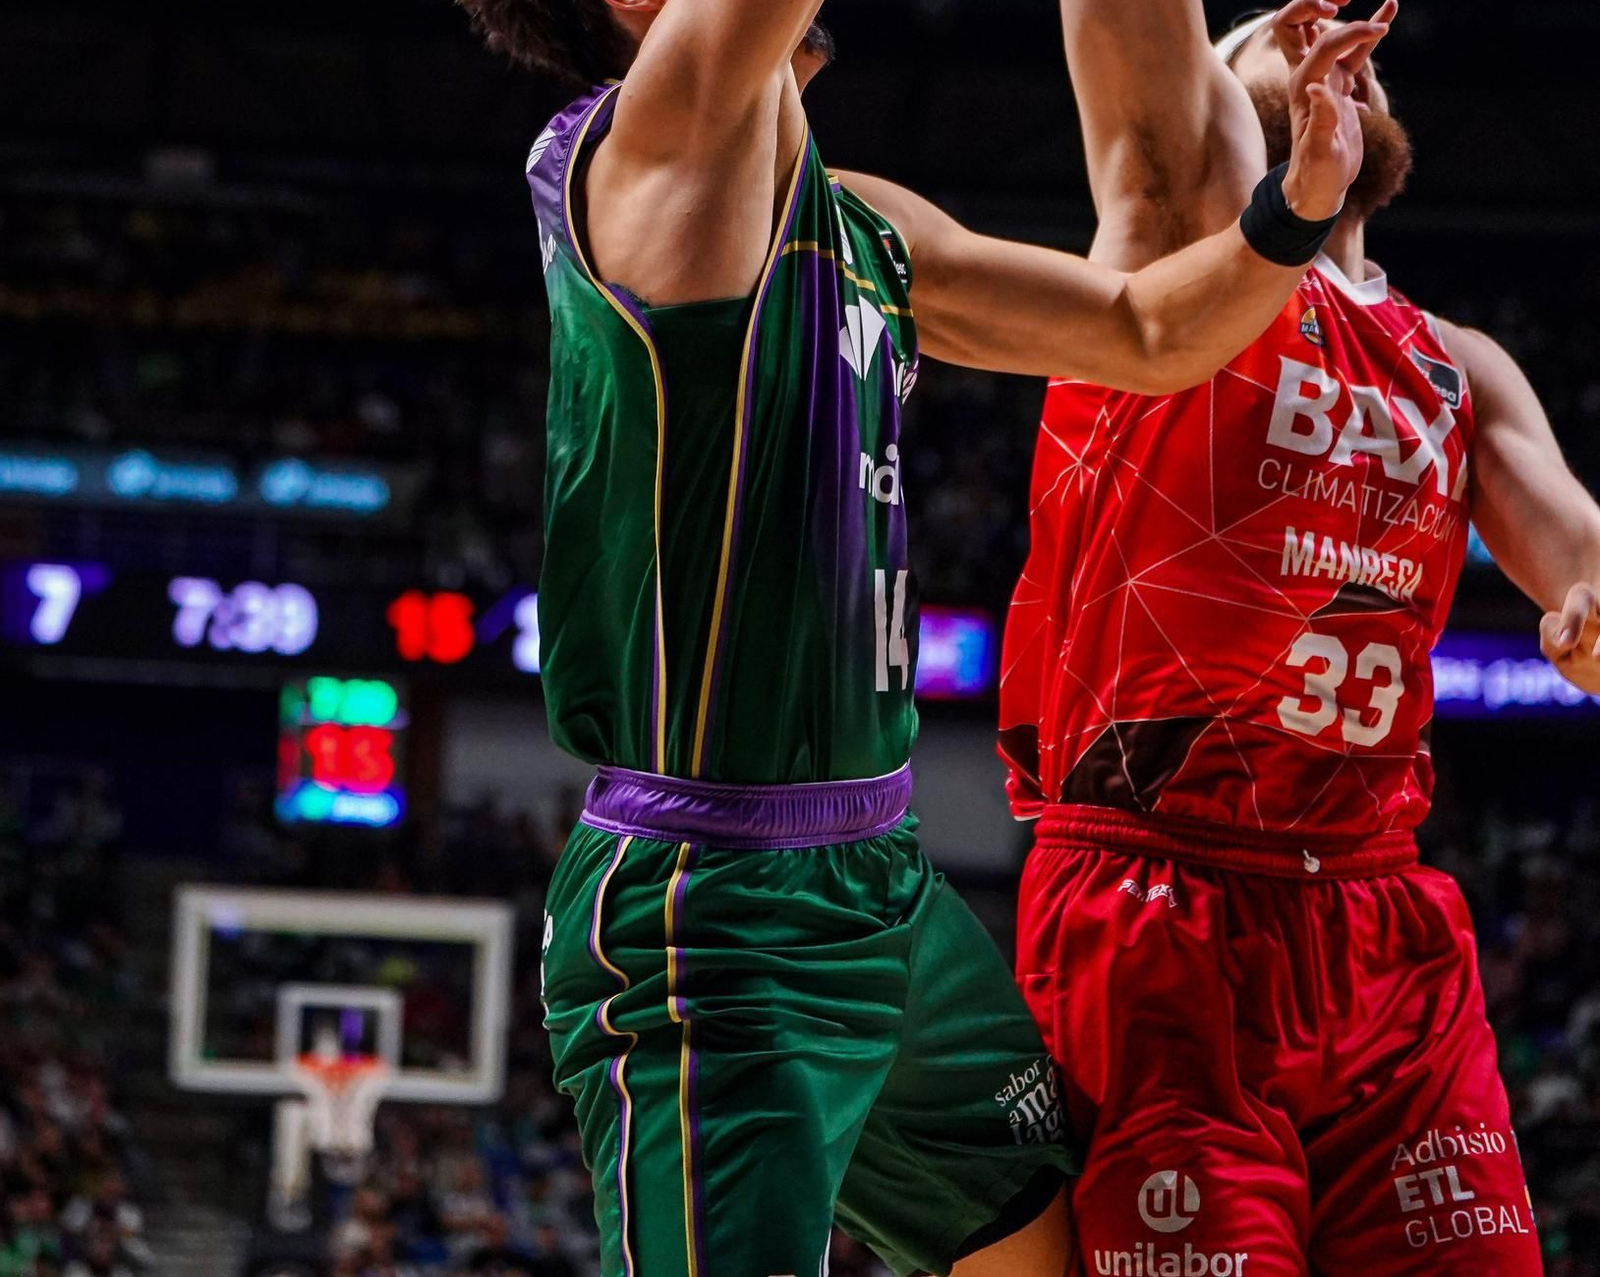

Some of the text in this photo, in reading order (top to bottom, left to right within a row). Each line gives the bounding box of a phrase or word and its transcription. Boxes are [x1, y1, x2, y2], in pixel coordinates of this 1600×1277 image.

[1279, 525, 1424, 600] MANRESA
[27, 564, 82, 644] 7
[874, 568, 910, 692] 14
[1276, 632, 1405, 747] 33
[995, 1060, 1040, 1107] sabor
[1391, 1123, 1506, 1171] Adbisio
[1394, 1165, 1476, 1212] ETL
[1405, 1205, 1529, 1248] GLOBAL
[1094, 1242, 1248, 1277] unilabor
